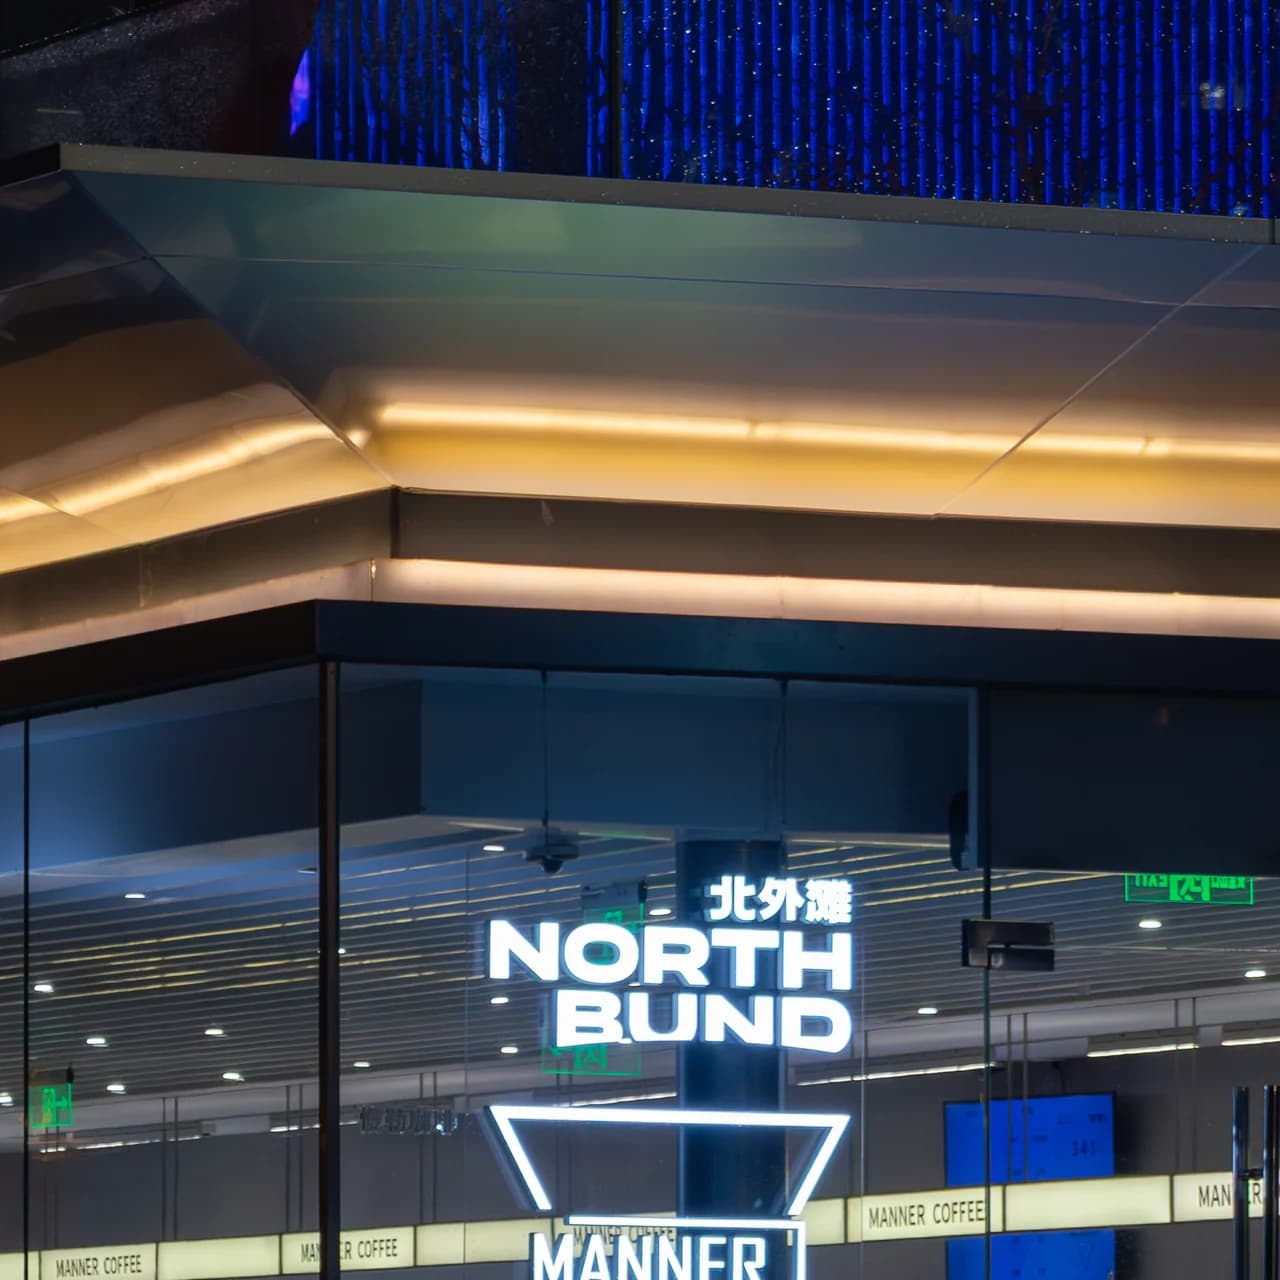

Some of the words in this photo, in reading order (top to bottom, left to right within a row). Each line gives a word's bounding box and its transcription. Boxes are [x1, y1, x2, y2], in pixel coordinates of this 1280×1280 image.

[487, 920, 852, 991] NORTH
[555, 989, 852, 1053] BUND
[868, 1204, 926, 1229] MANNER
[932, 1199, 986, 1225] COFFEE
[357, 1238, 398, 1259] COFFEE
[56, 1257, 99, 1278] MANNER
[103, 1254, 142, 1275] COFFEE
